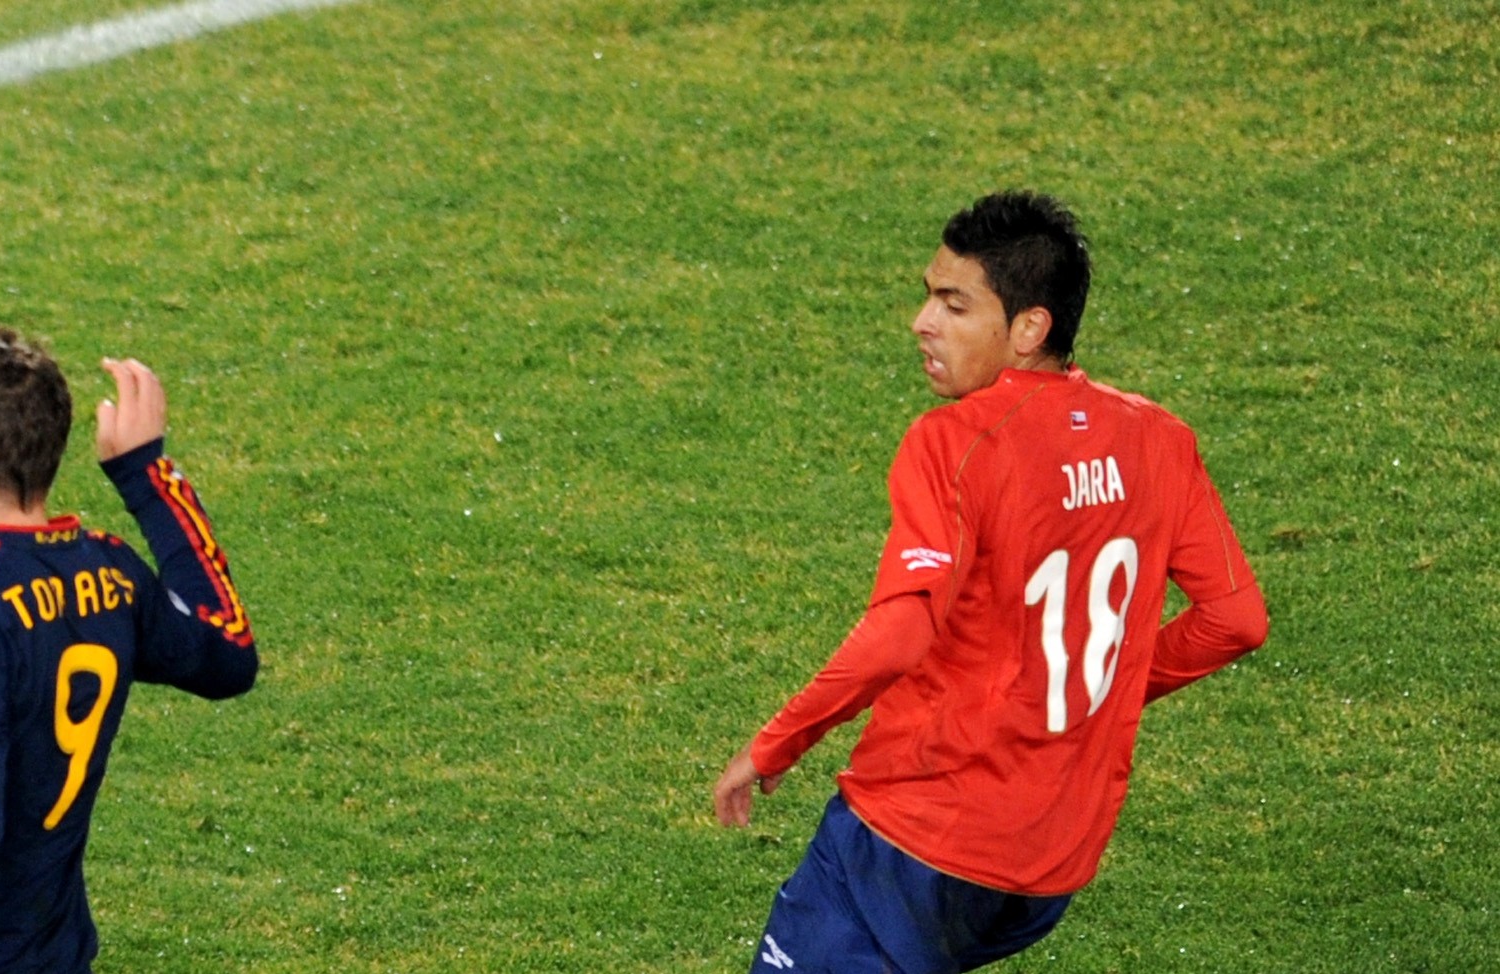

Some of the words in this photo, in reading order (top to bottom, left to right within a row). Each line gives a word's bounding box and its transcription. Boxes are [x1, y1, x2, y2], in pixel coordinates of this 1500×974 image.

[1061, 455, 1125, 511] JARA
[1025, 536, 1138, 733] 18
[43, 642, 118, 831] 9
